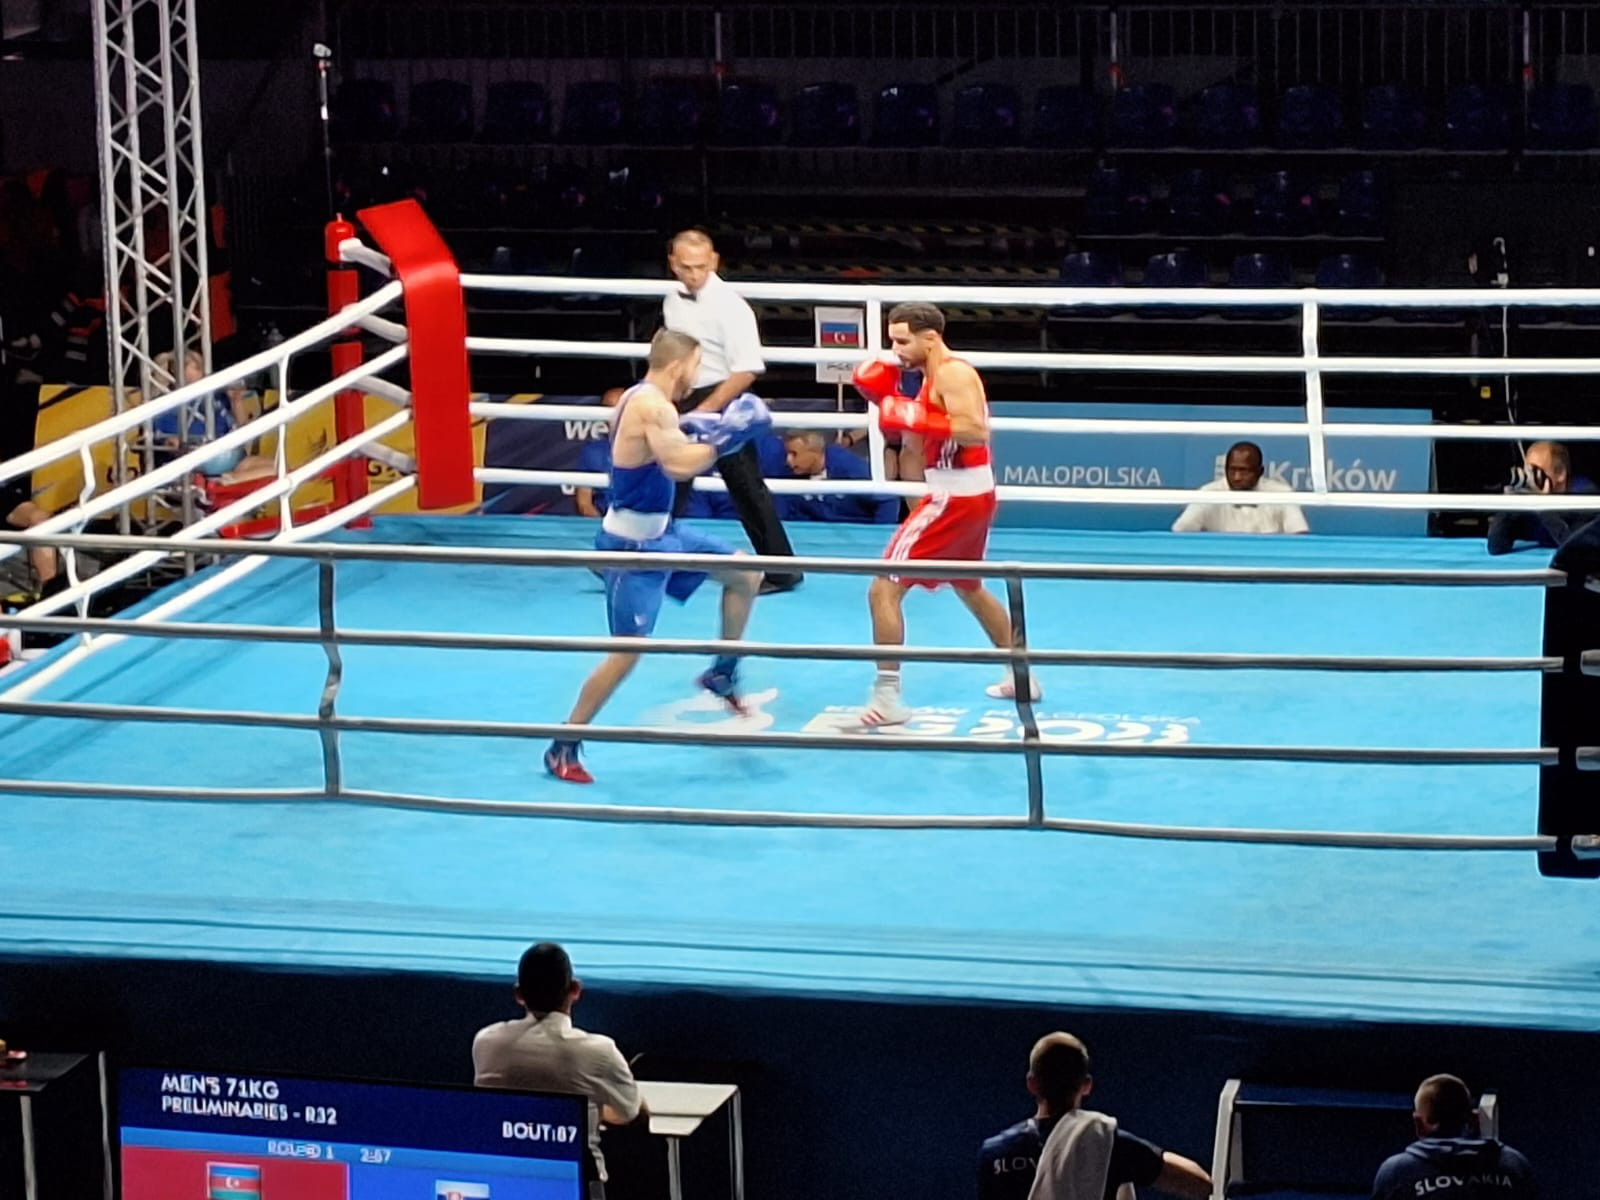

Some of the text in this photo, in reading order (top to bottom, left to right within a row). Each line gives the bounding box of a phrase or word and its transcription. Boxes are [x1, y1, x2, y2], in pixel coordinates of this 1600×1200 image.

[1003, 465, 1162, 487] MAŁOPOLSKA
[225, 1077, 280, 1100] 71KG
[161, 1095, 289, 1121] PRELIMINARIES
[1414, 1173, 1512, 1196] SLOVAKIA
